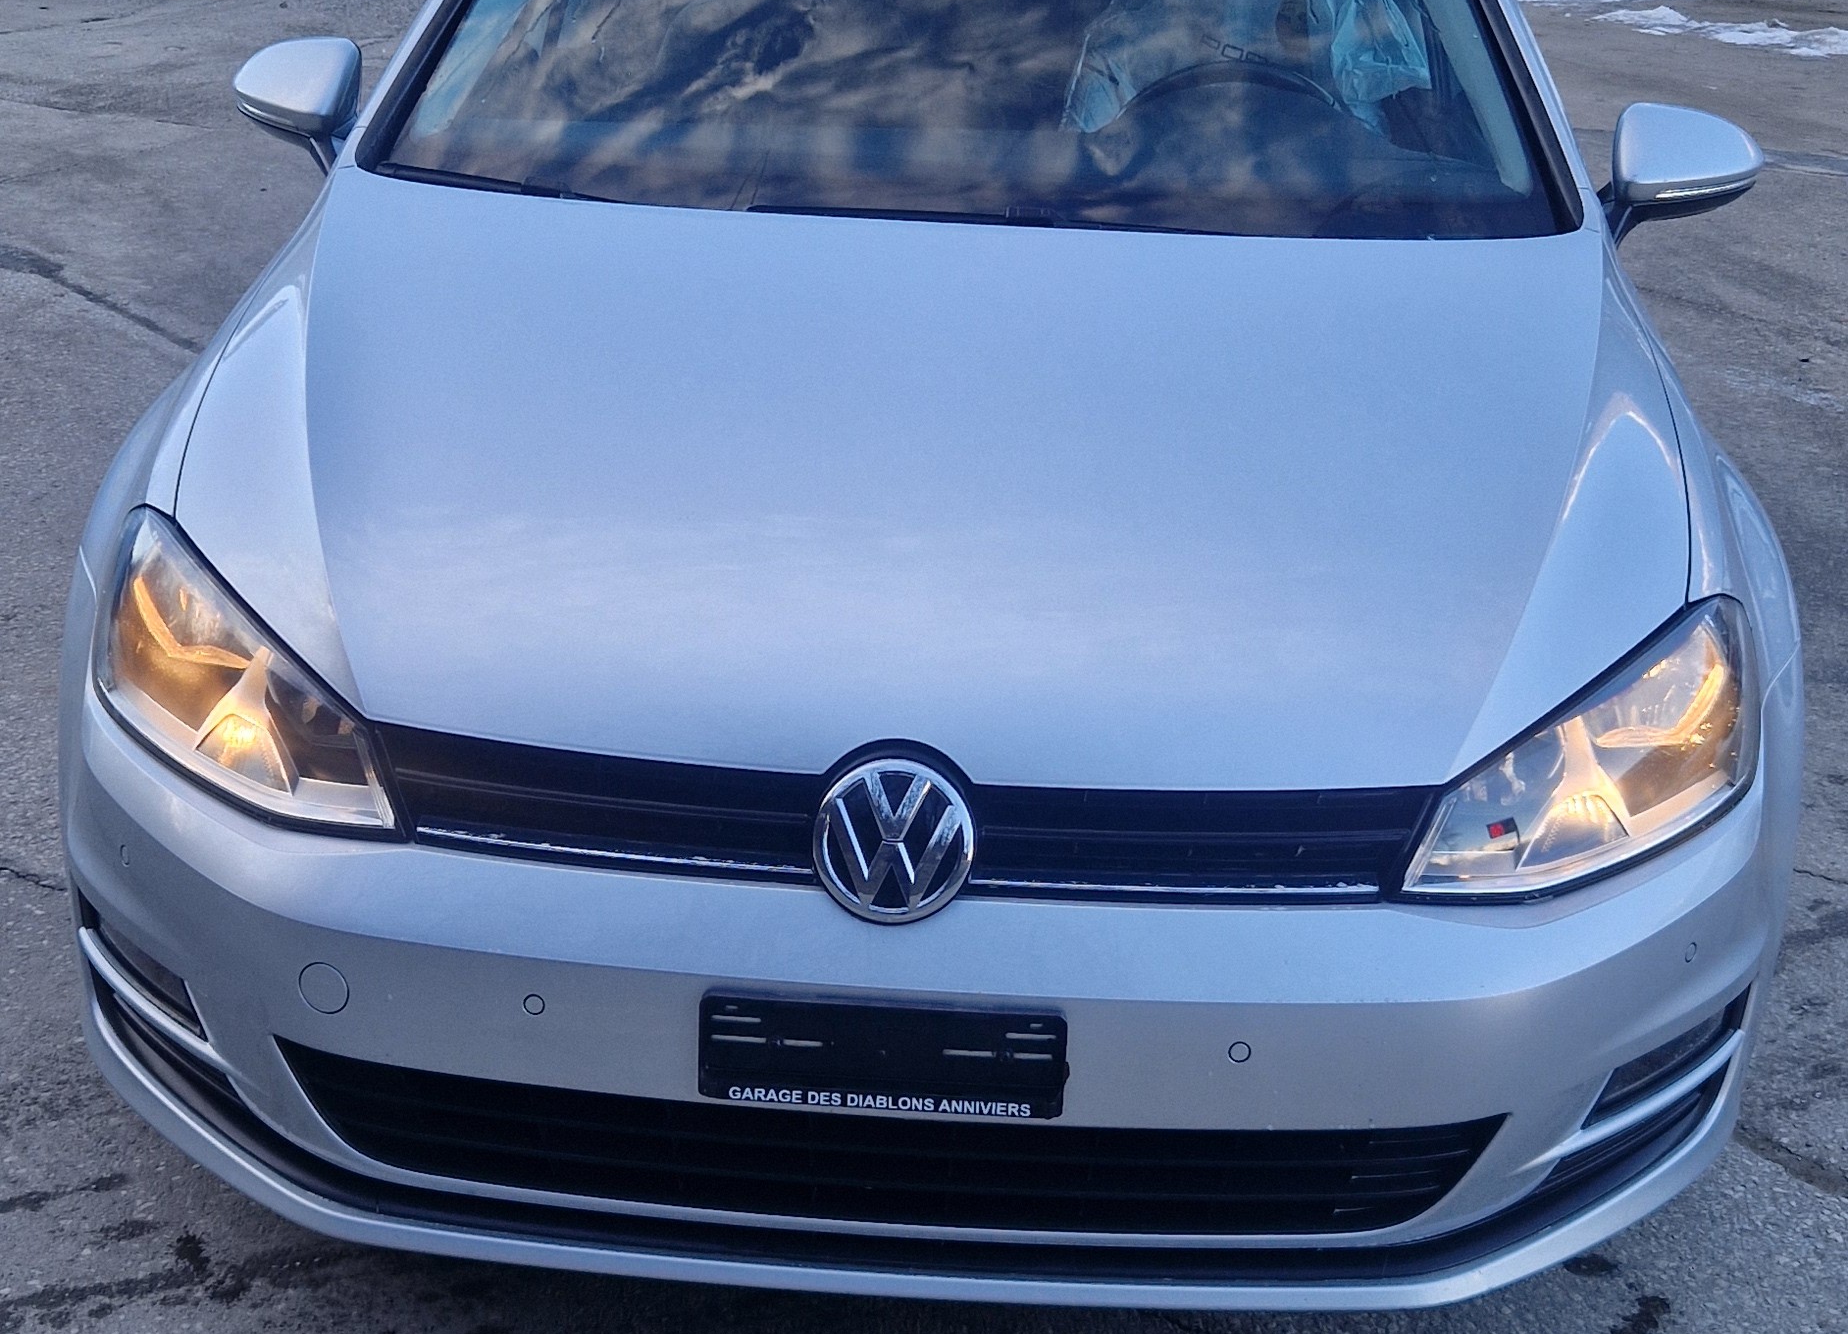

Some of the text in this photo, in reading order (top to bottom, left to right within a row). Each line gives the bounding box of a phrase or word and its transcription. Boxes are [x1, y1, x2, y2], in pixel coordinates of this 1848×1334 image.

[820, 765, 968, 917] VW
[728, 1086, 1031, 1117] GARAGE DES DIABLONS ANNIVIERS
